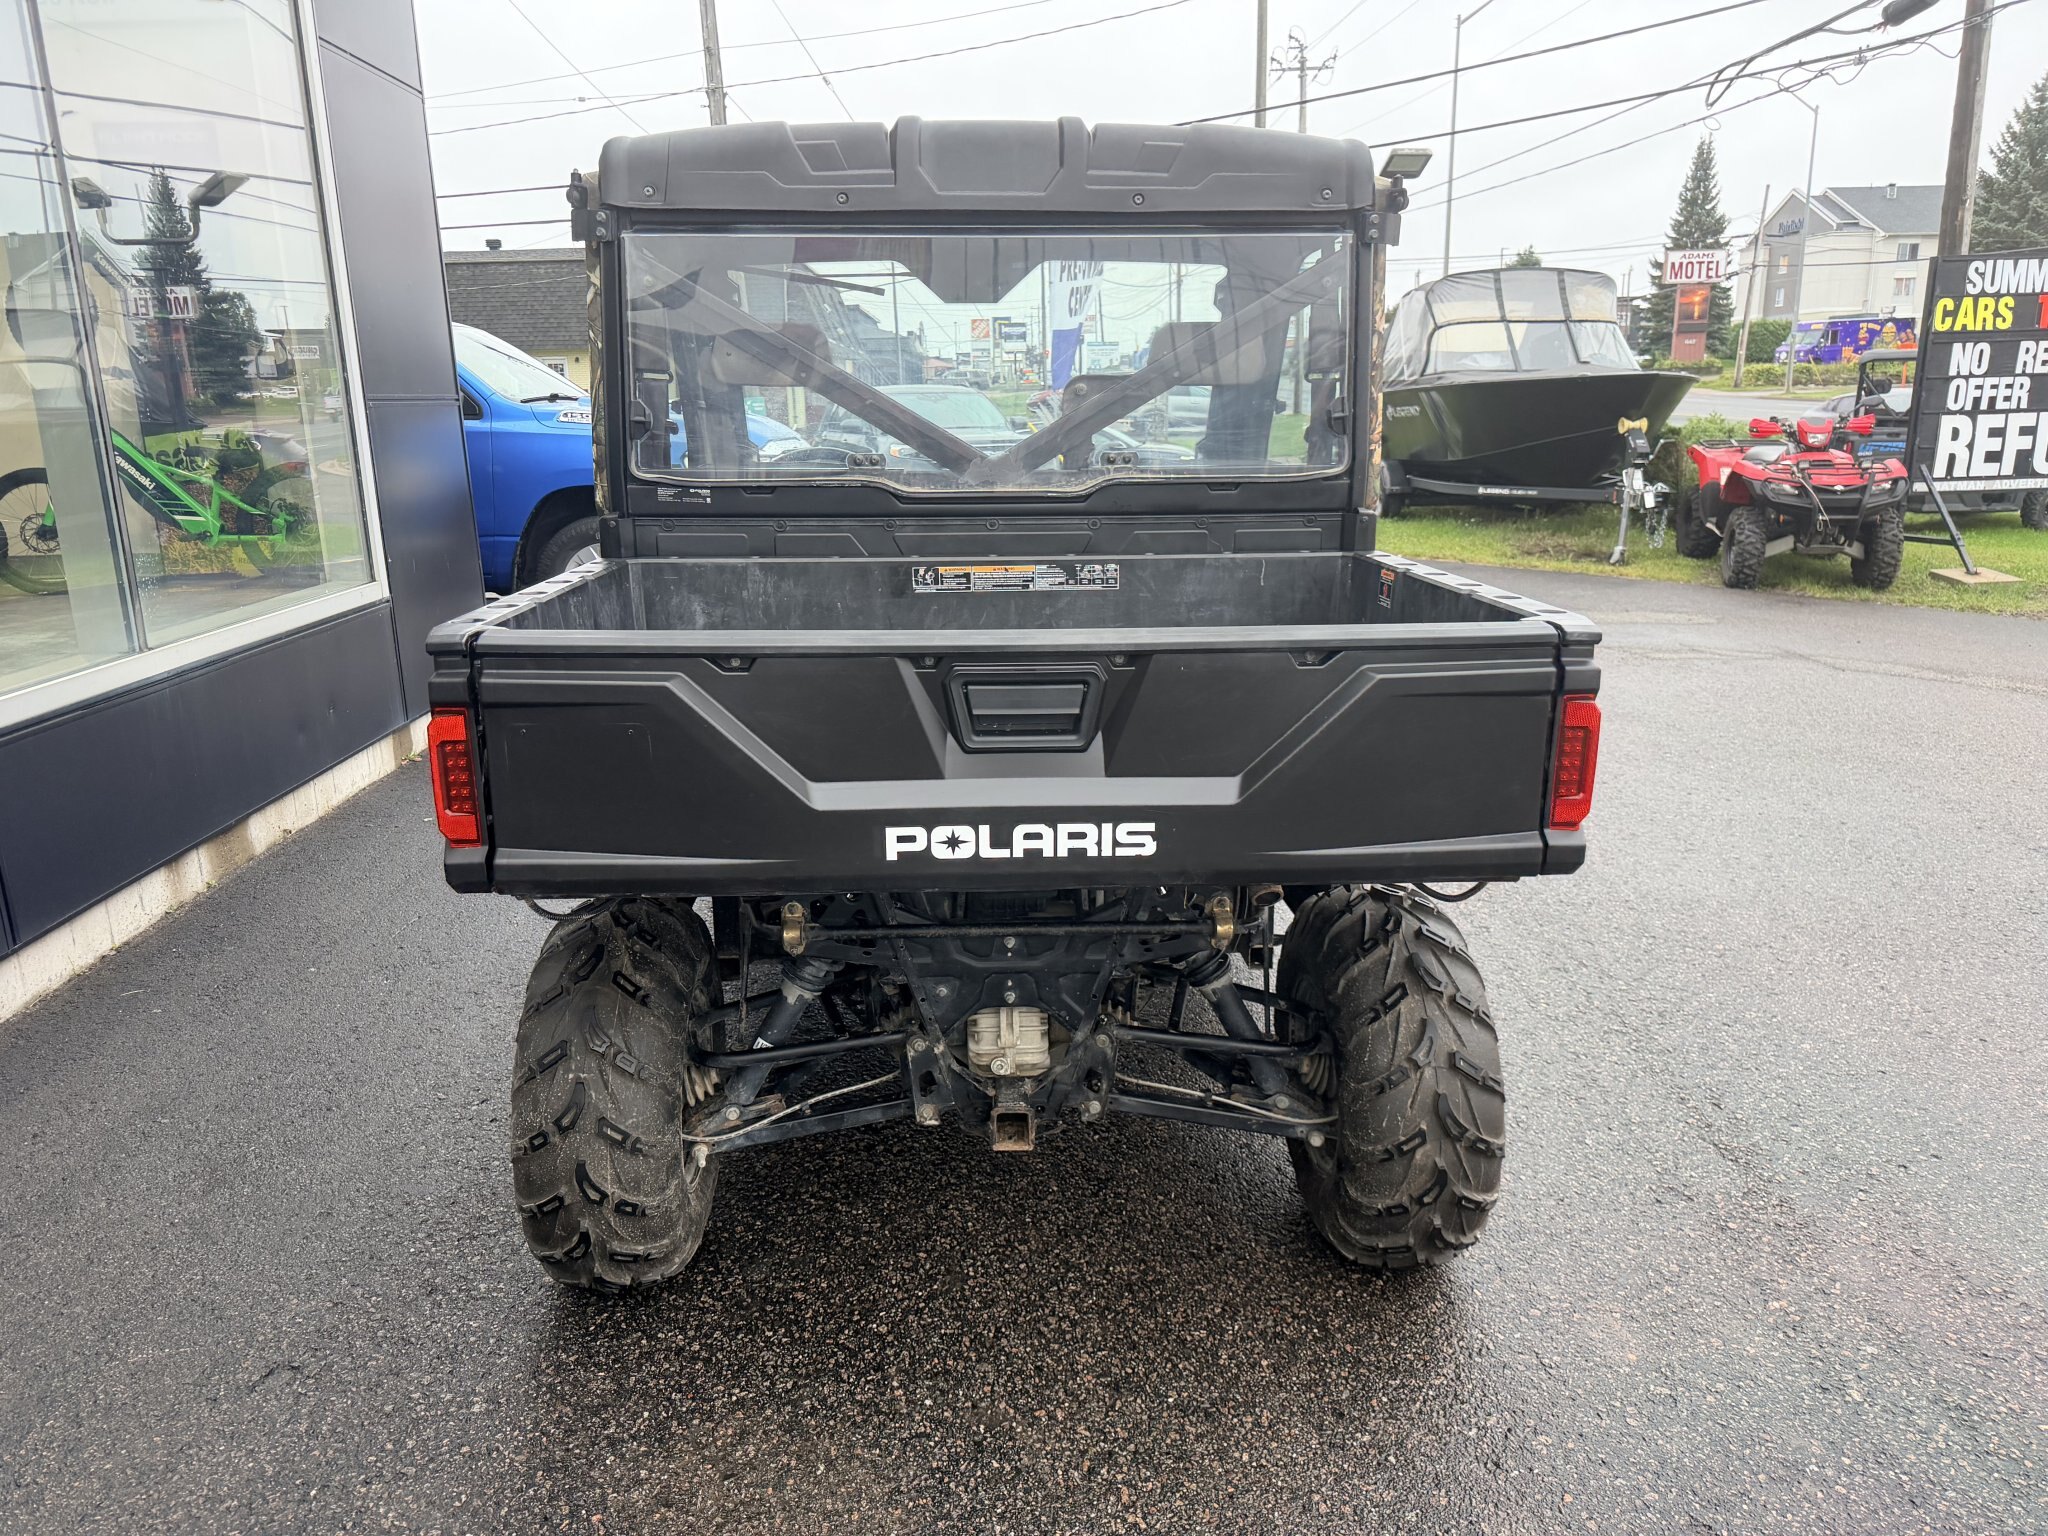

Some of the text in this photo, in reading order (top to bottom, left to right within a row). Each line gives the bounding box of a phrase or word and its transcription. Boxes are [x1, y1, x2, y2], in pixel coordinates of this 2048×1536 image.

[1669, 260, 1722, 280] MOTEL
[1680, 252, 1716, 260] ADAMS
[1965, 258, 2048, 295] SUMM
[1933, 295, 2015, 332] CARS
[1948, 340, 2048, 377] NO RE
[1946, 376, 2031, 411] OFFER
[114, 451, 156, 491] awasaki
[885, 822, 1157, 861] POLARIS
